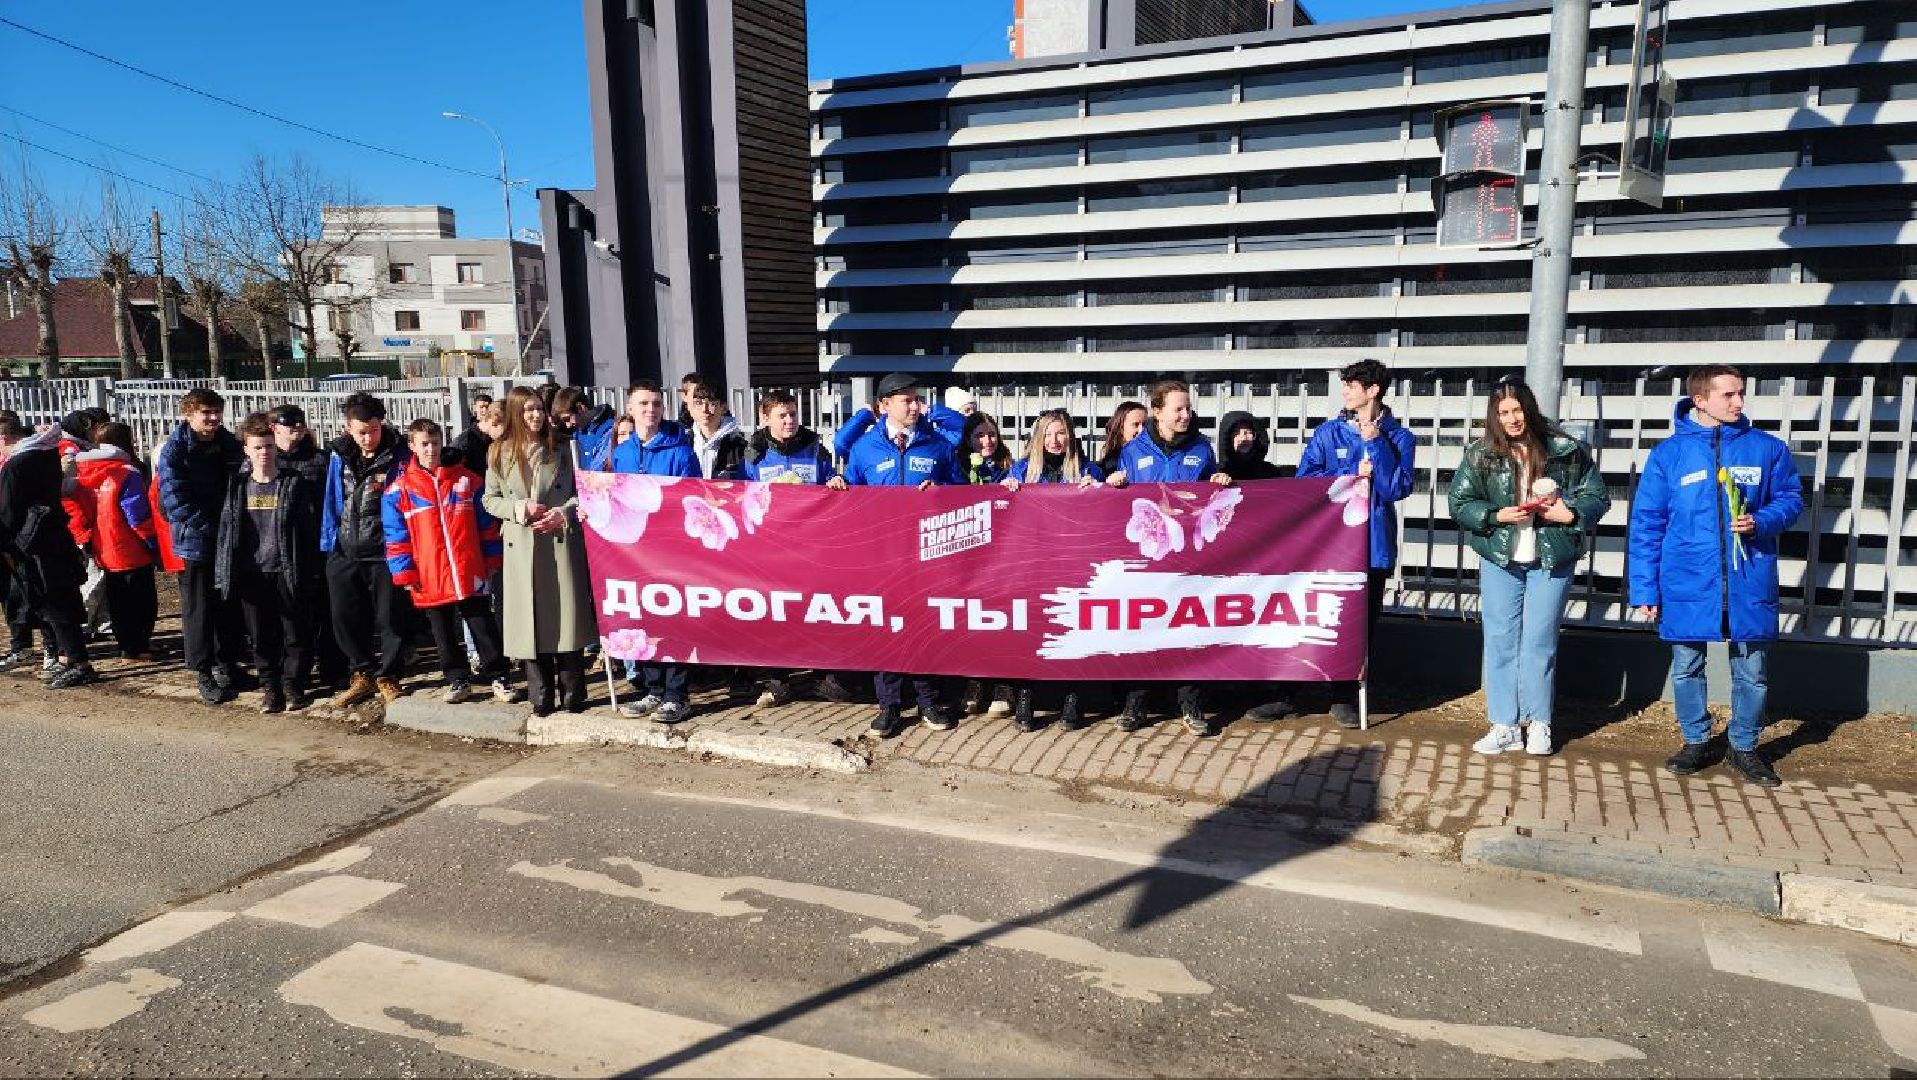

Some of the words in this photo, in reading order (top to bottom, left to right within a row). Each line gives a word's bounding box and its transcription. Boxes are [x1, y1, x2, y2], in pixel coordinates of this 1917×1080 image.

[602, 578, 904, 633] ДОРОГАЯ,
[927, 598, 1028, 631] ТЫ
[1078, 592, 1320, 631] ПРАВА!
